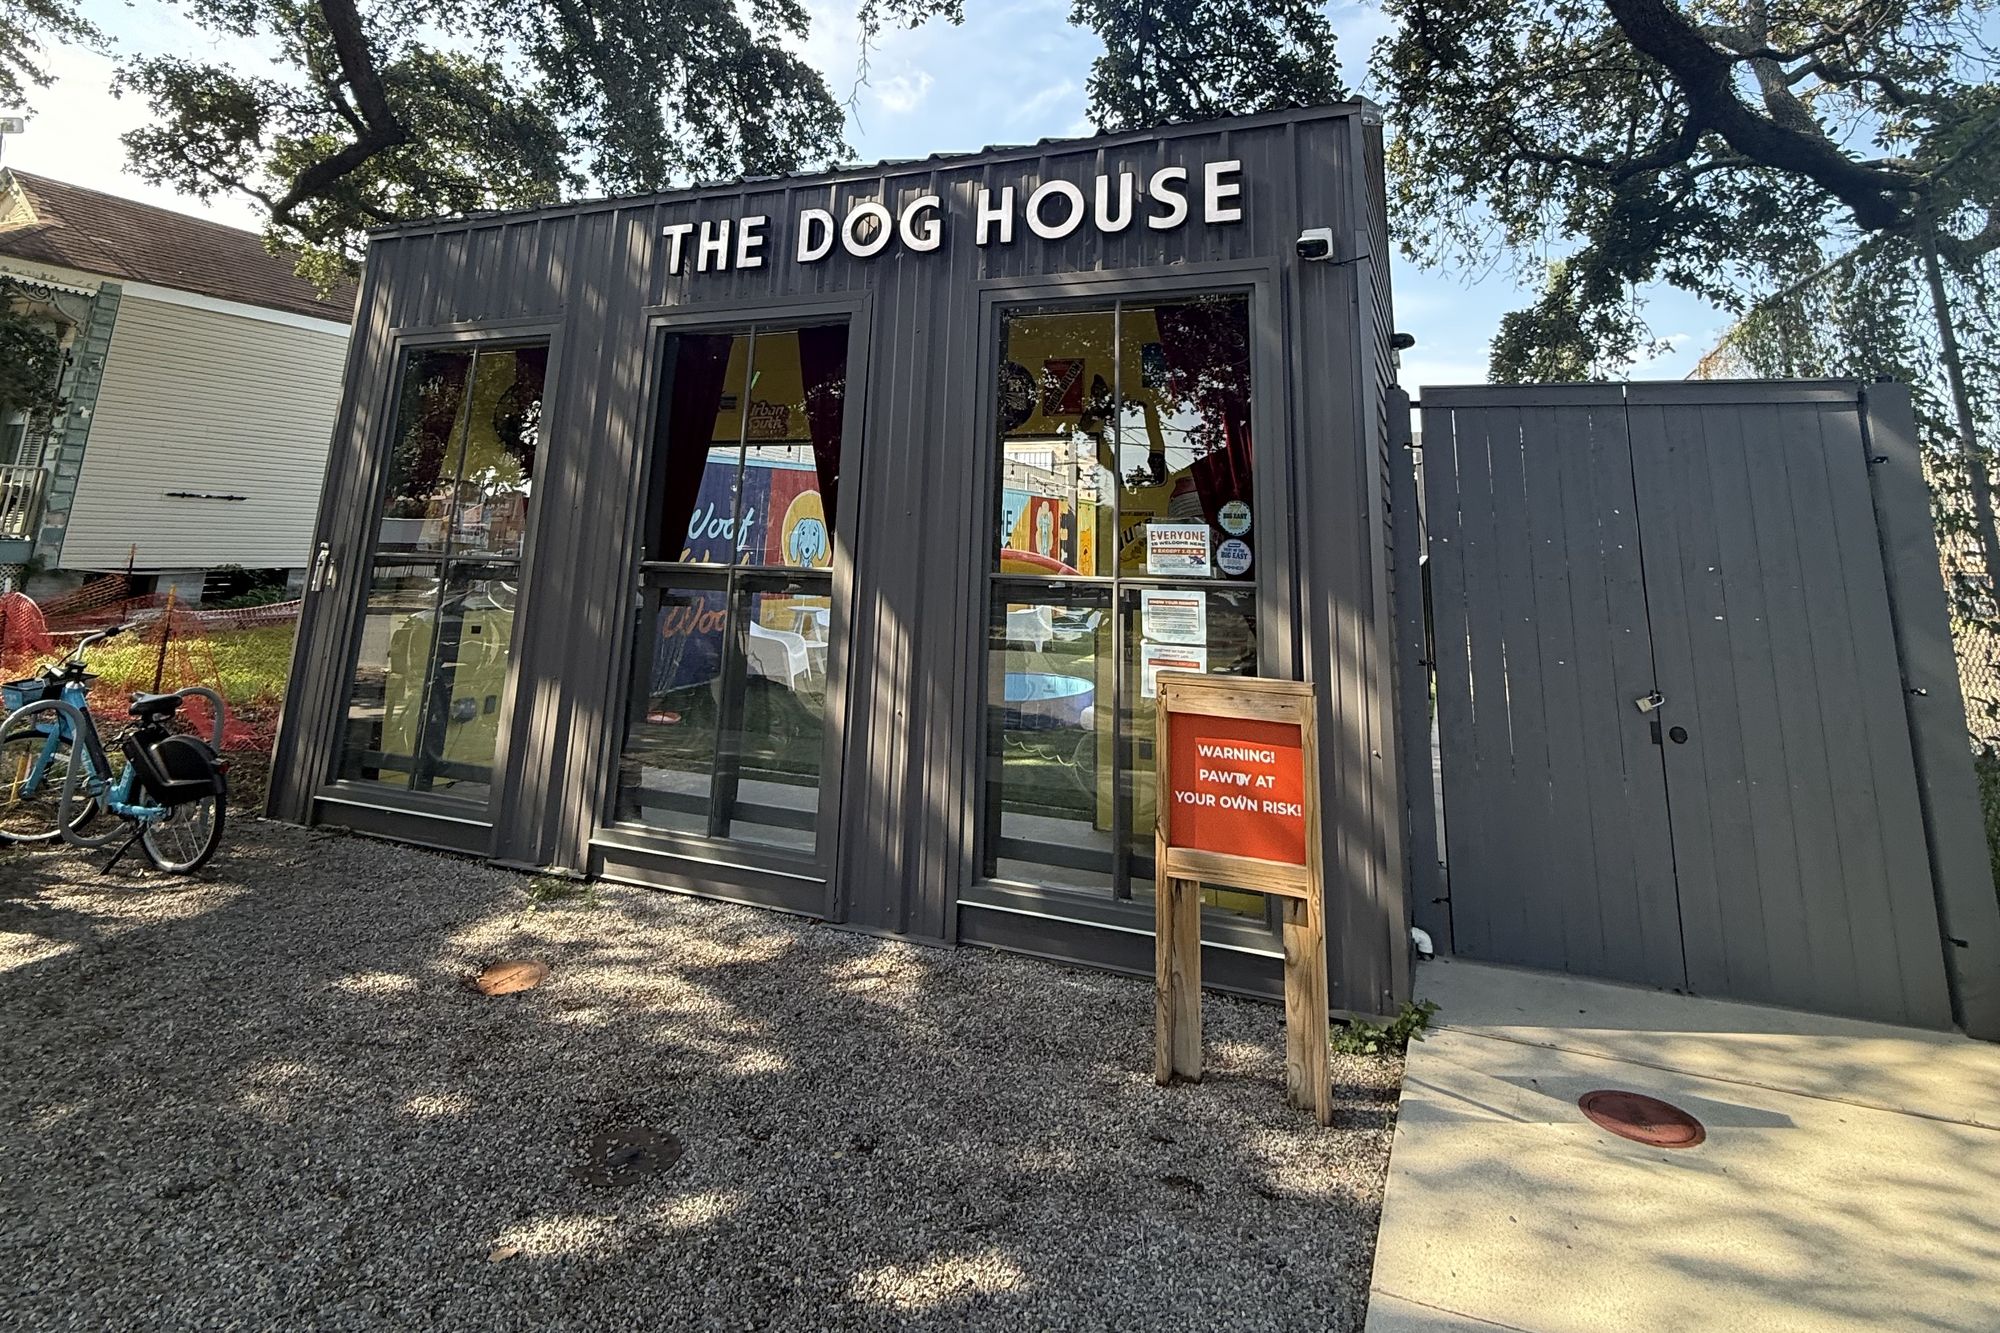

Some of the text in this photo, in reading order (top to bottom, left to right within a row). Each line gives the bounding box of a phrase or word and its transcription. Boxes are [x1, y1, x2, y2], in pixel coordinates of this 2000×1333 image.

[662, 159, 1243, 276] THE DOG HOUSE
[1150, 530, 1206, 542] EVERYONE
[1232, 552, 1248, 560] EASY
[662, 597, 727, 639] Woo
[1198, 744, 1275, 764] WARNING!
[1200, 769, 1275, 789] PAWTY AT
[1175, 790, 1302, 817] YOUR OWN RISK!
